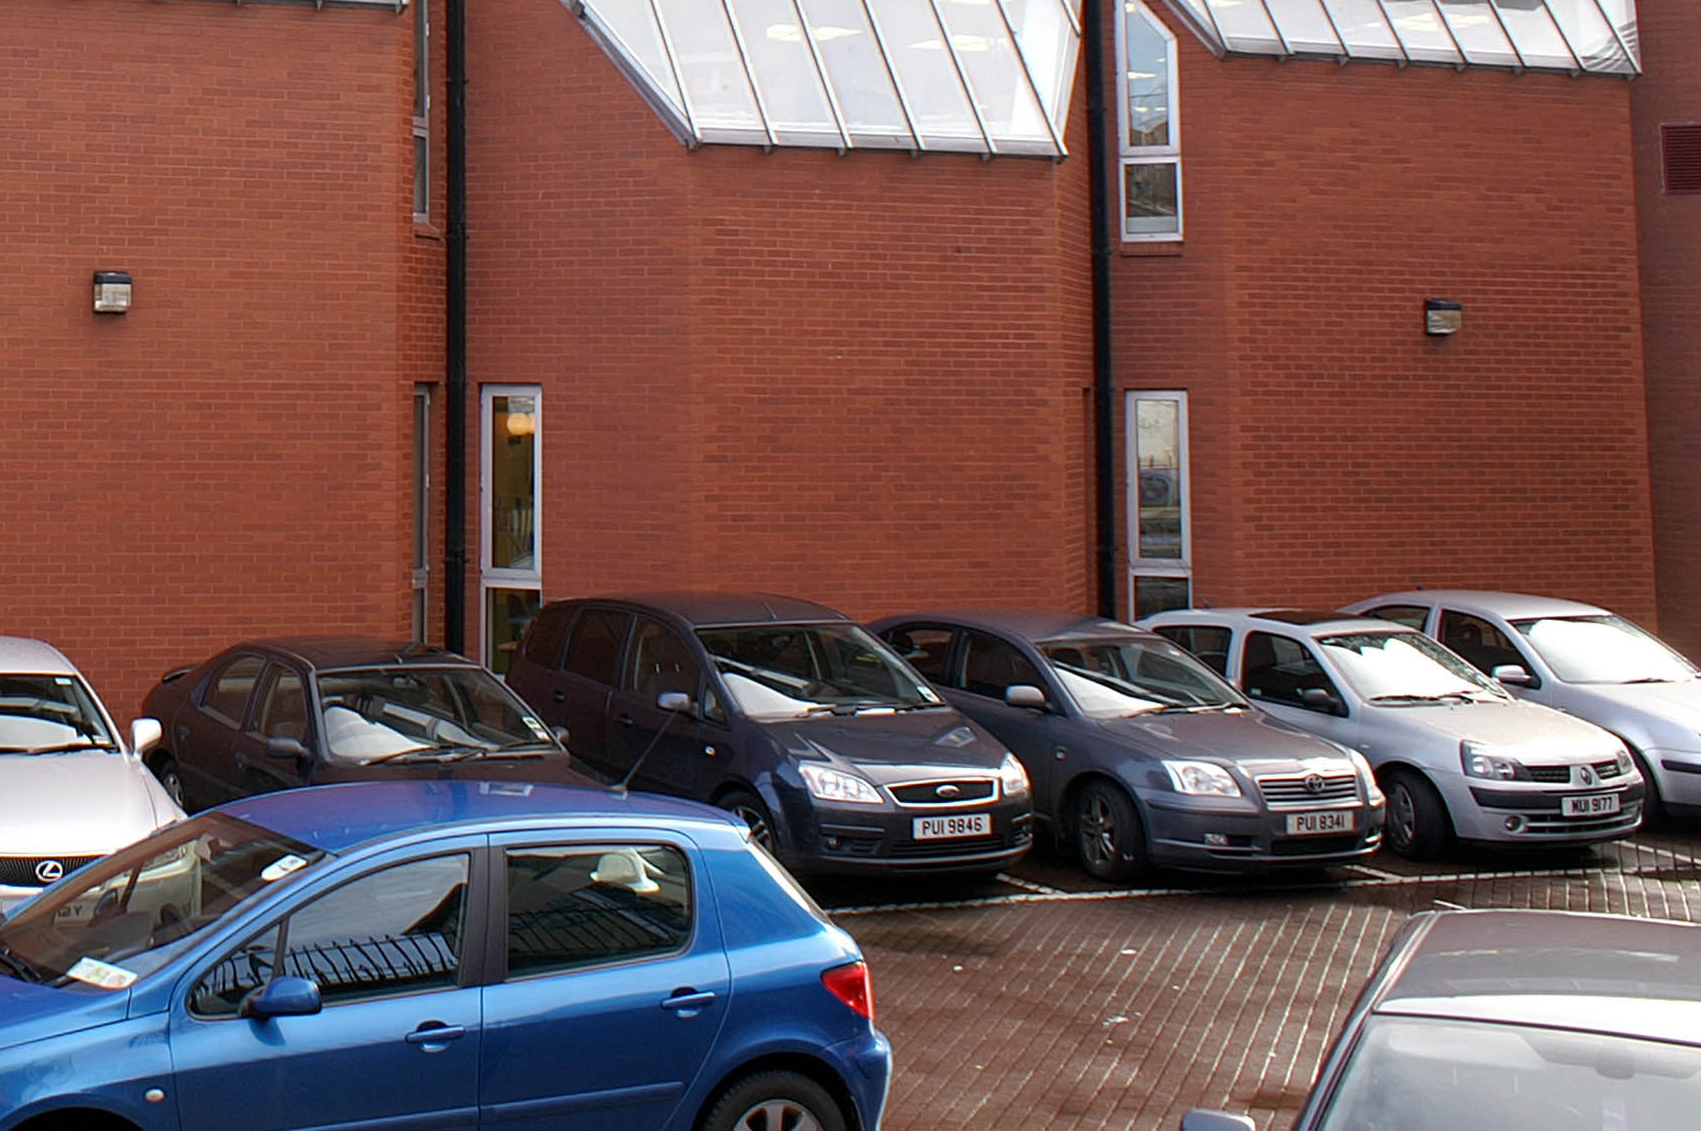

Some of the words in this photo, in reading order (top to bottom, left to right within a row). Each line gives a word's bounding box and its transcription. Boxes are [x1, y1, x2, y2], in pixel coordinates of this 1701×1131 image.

[1591, 797, 1612, 811] 9177
[922, 820, 945, 835] PUI
[948, 817, 982, 834] 9846
[1297, 815, 1316, 830] PUI
[1319, 814, 1345, 829] 8341
